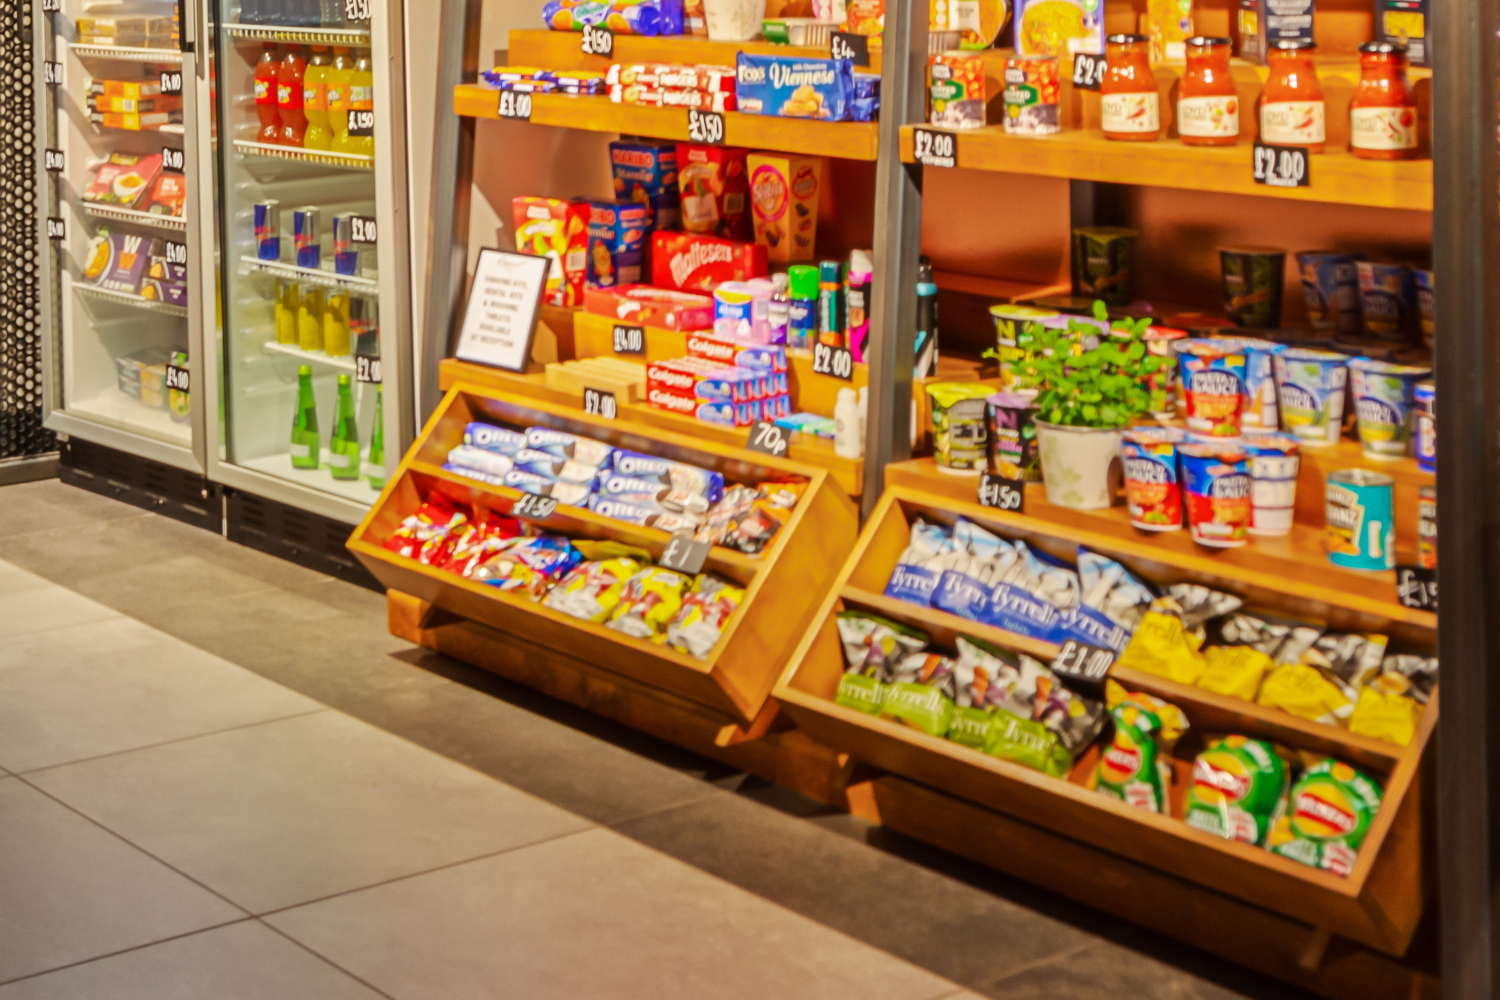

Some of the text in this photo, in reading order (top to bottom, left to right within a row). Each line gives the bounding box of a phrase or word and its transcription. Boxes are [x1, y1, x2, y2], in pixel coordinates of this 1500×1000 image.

[769, 63, 835, 90] Viennese
[499, 92, 531, 117] £1.00
[915, 130, 952, 158] £2.00
[613, 150, 654, 167] HARIBO
[1254, 147, 1304, 181] £2.00
[669, 241, 732, 288] Maltesers
[688, 338, 734, 359] Colgate
[813, 342, 851, 377] £2.00
[648, 367, 694, 389] Colgate
[649, 389, 696, 412] Colgate
[754, 422, 786, 455] 70p
[513, 493, 557, 518] £1.50
[978, 475, 1021, 509] £1.50
[663, 539, 691, 566] £1
[1053, 641, 1113, 679] £1.00
